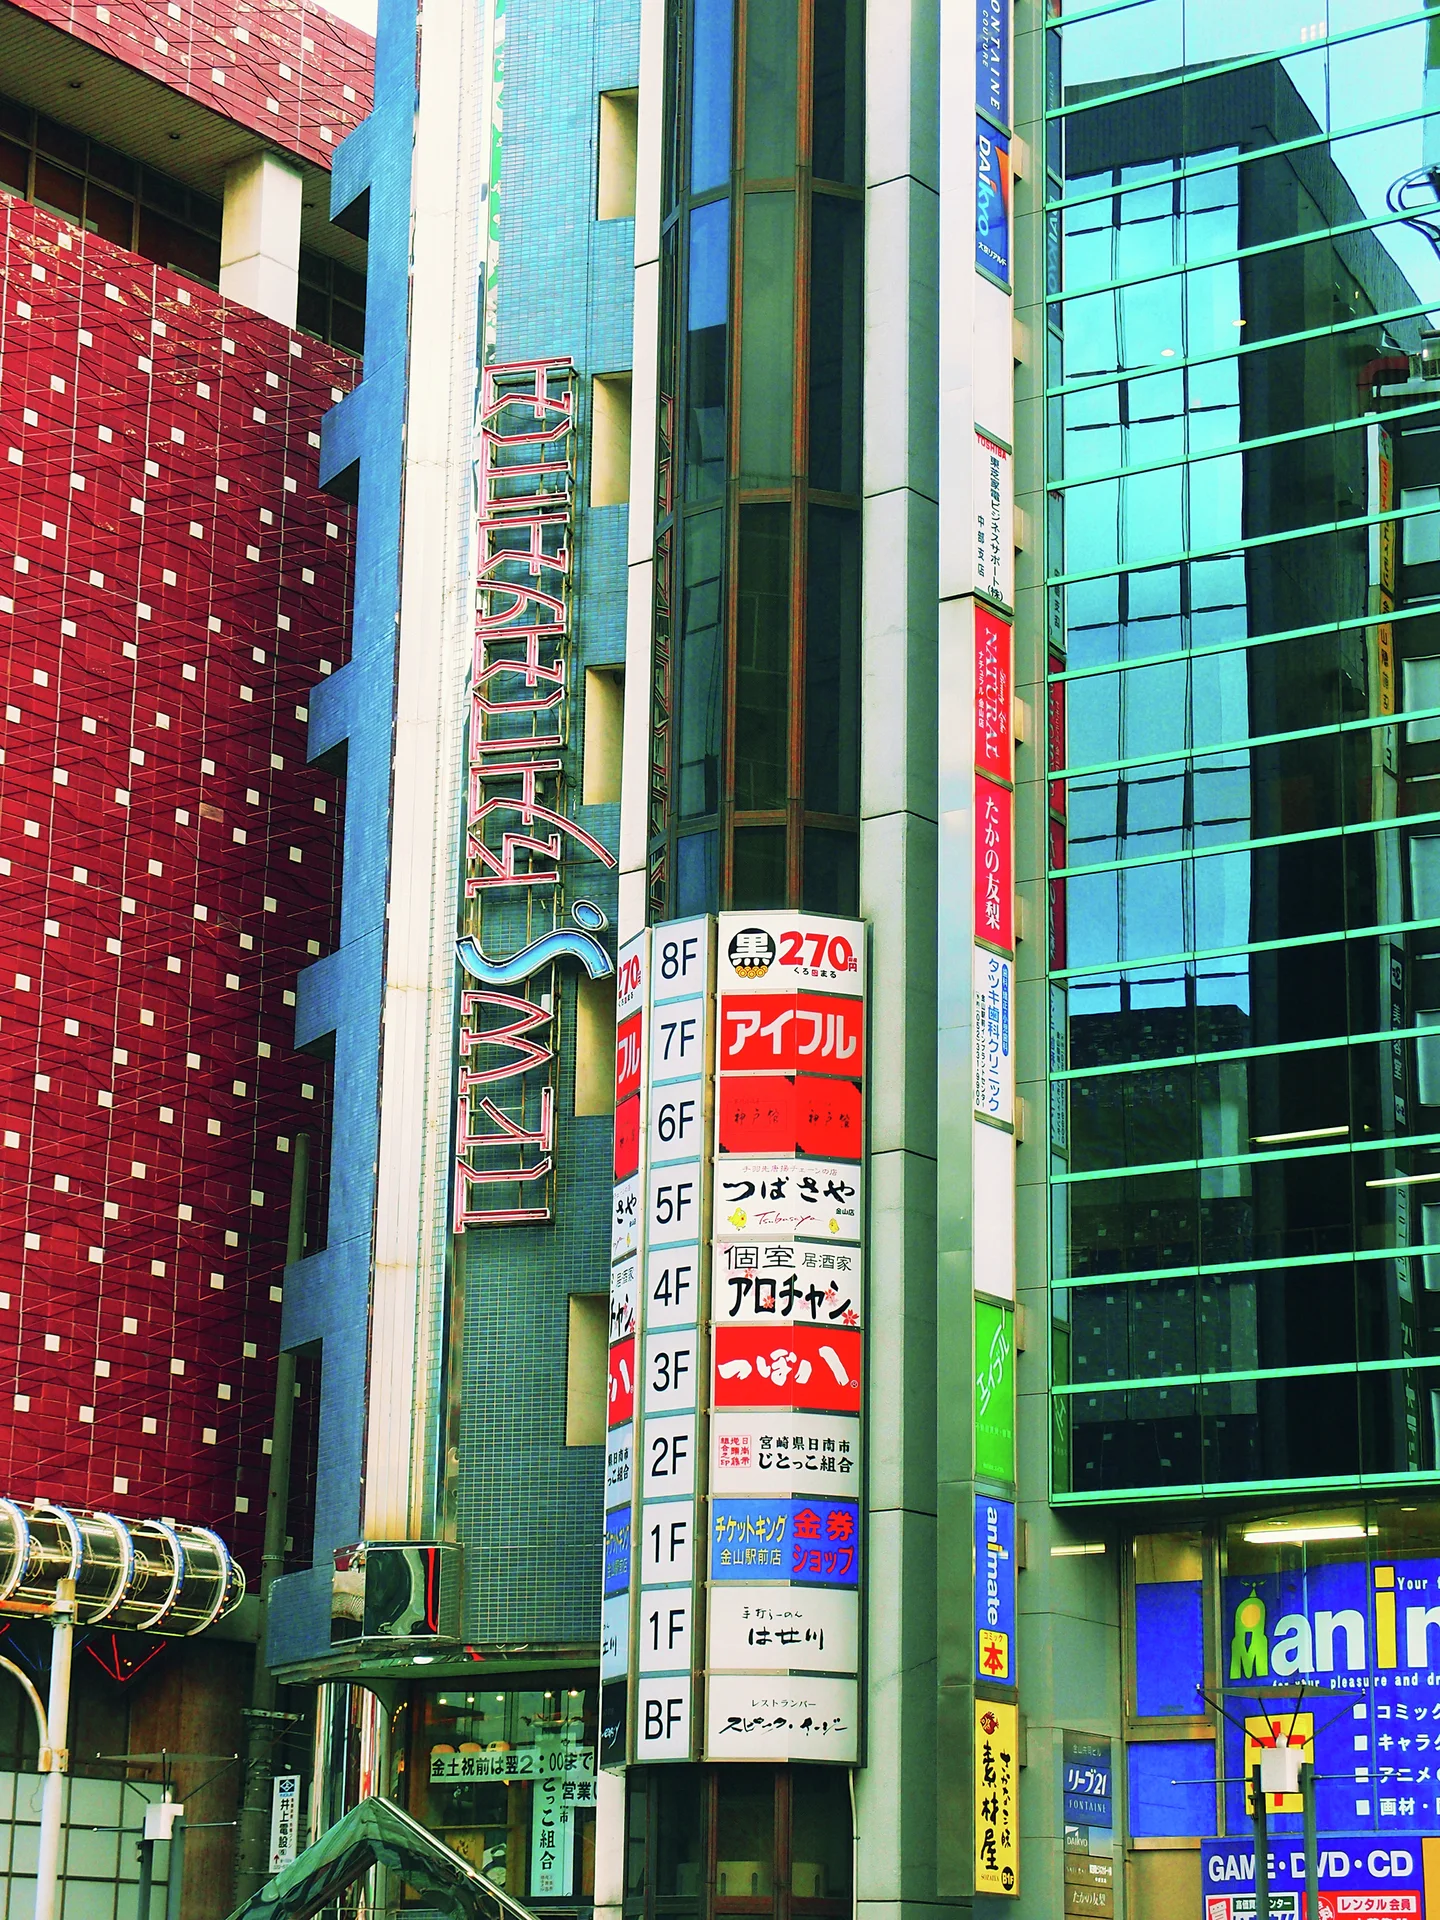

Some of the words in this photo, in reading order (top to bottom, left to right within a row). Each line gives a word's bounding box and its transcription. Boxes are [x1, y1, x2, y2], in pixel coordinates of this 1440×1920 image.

[981, 10, 989, 68] COUTURE
[976, 432, 1008, 461] TOSHIBA
[985, 627, 1001, 760] NATURAL
[985, 796, 1000, 930] たかの友梨
[660, 937, 698, 980] 8F
[730, 932, 773, 966] 黒
[660, 1018, 696, 1061] 7F
[726, 1009, 857, 1060] アイフル
[988, 958, 1000, 1113] タツキ歯科クリニック
[657, 1100, 695, 1142] 6F
[655, 1182, 693, 1225] 5F
[723, 1176, 855, 1204] つばさや
[724, 1245, 796, 1270] 個室
[802, 1252, 852, 1271] 居酒家
[653, 1266, 692, 1307] 4F
[728, 1273, 852, 1320] アロチャン
[652, 1349, 690, 1392] 3F
[718, 1345, 850, 1387] つぼ八
[650, 1435, 688, 1477] 2F
[759, 1435, 850, 1453] 宮崎県日南市
[759, 1453, 854, 1473] じとっこ組合
[715, 1513, 788, 1543] チケットキング
[793, 1508, 854, 1541] 金券
[651, 1521, 686, 1563] 1F
[720, 1548, 782, 1565] 金山駅前店
[793, 1544, 854, 1575] ショップ
[987, 1506, 1009, 1626] animate
[1397, 1577, 1428, 1591] Your
[649, 1609, 685, 1651] 1F
[983, 1632, 1003, 1643] コミック
[983, 1642, 1004, 1675] 本
[1331, 1675, 1387, 1690] pleasure
[1395, 1673, 1419, 1686] and
[645, 1699, 683, 1741] BF
[751, 1699, 817, 1708] レストランバー
[1069, 1768, 1107, 1795] リーブ21
[1069, 1799, 1106, 1813] FONTAINE
[1380, 1797, 1440, 1816] 画材・
[1341, 1897, 1412, 1911] レンタル会員
